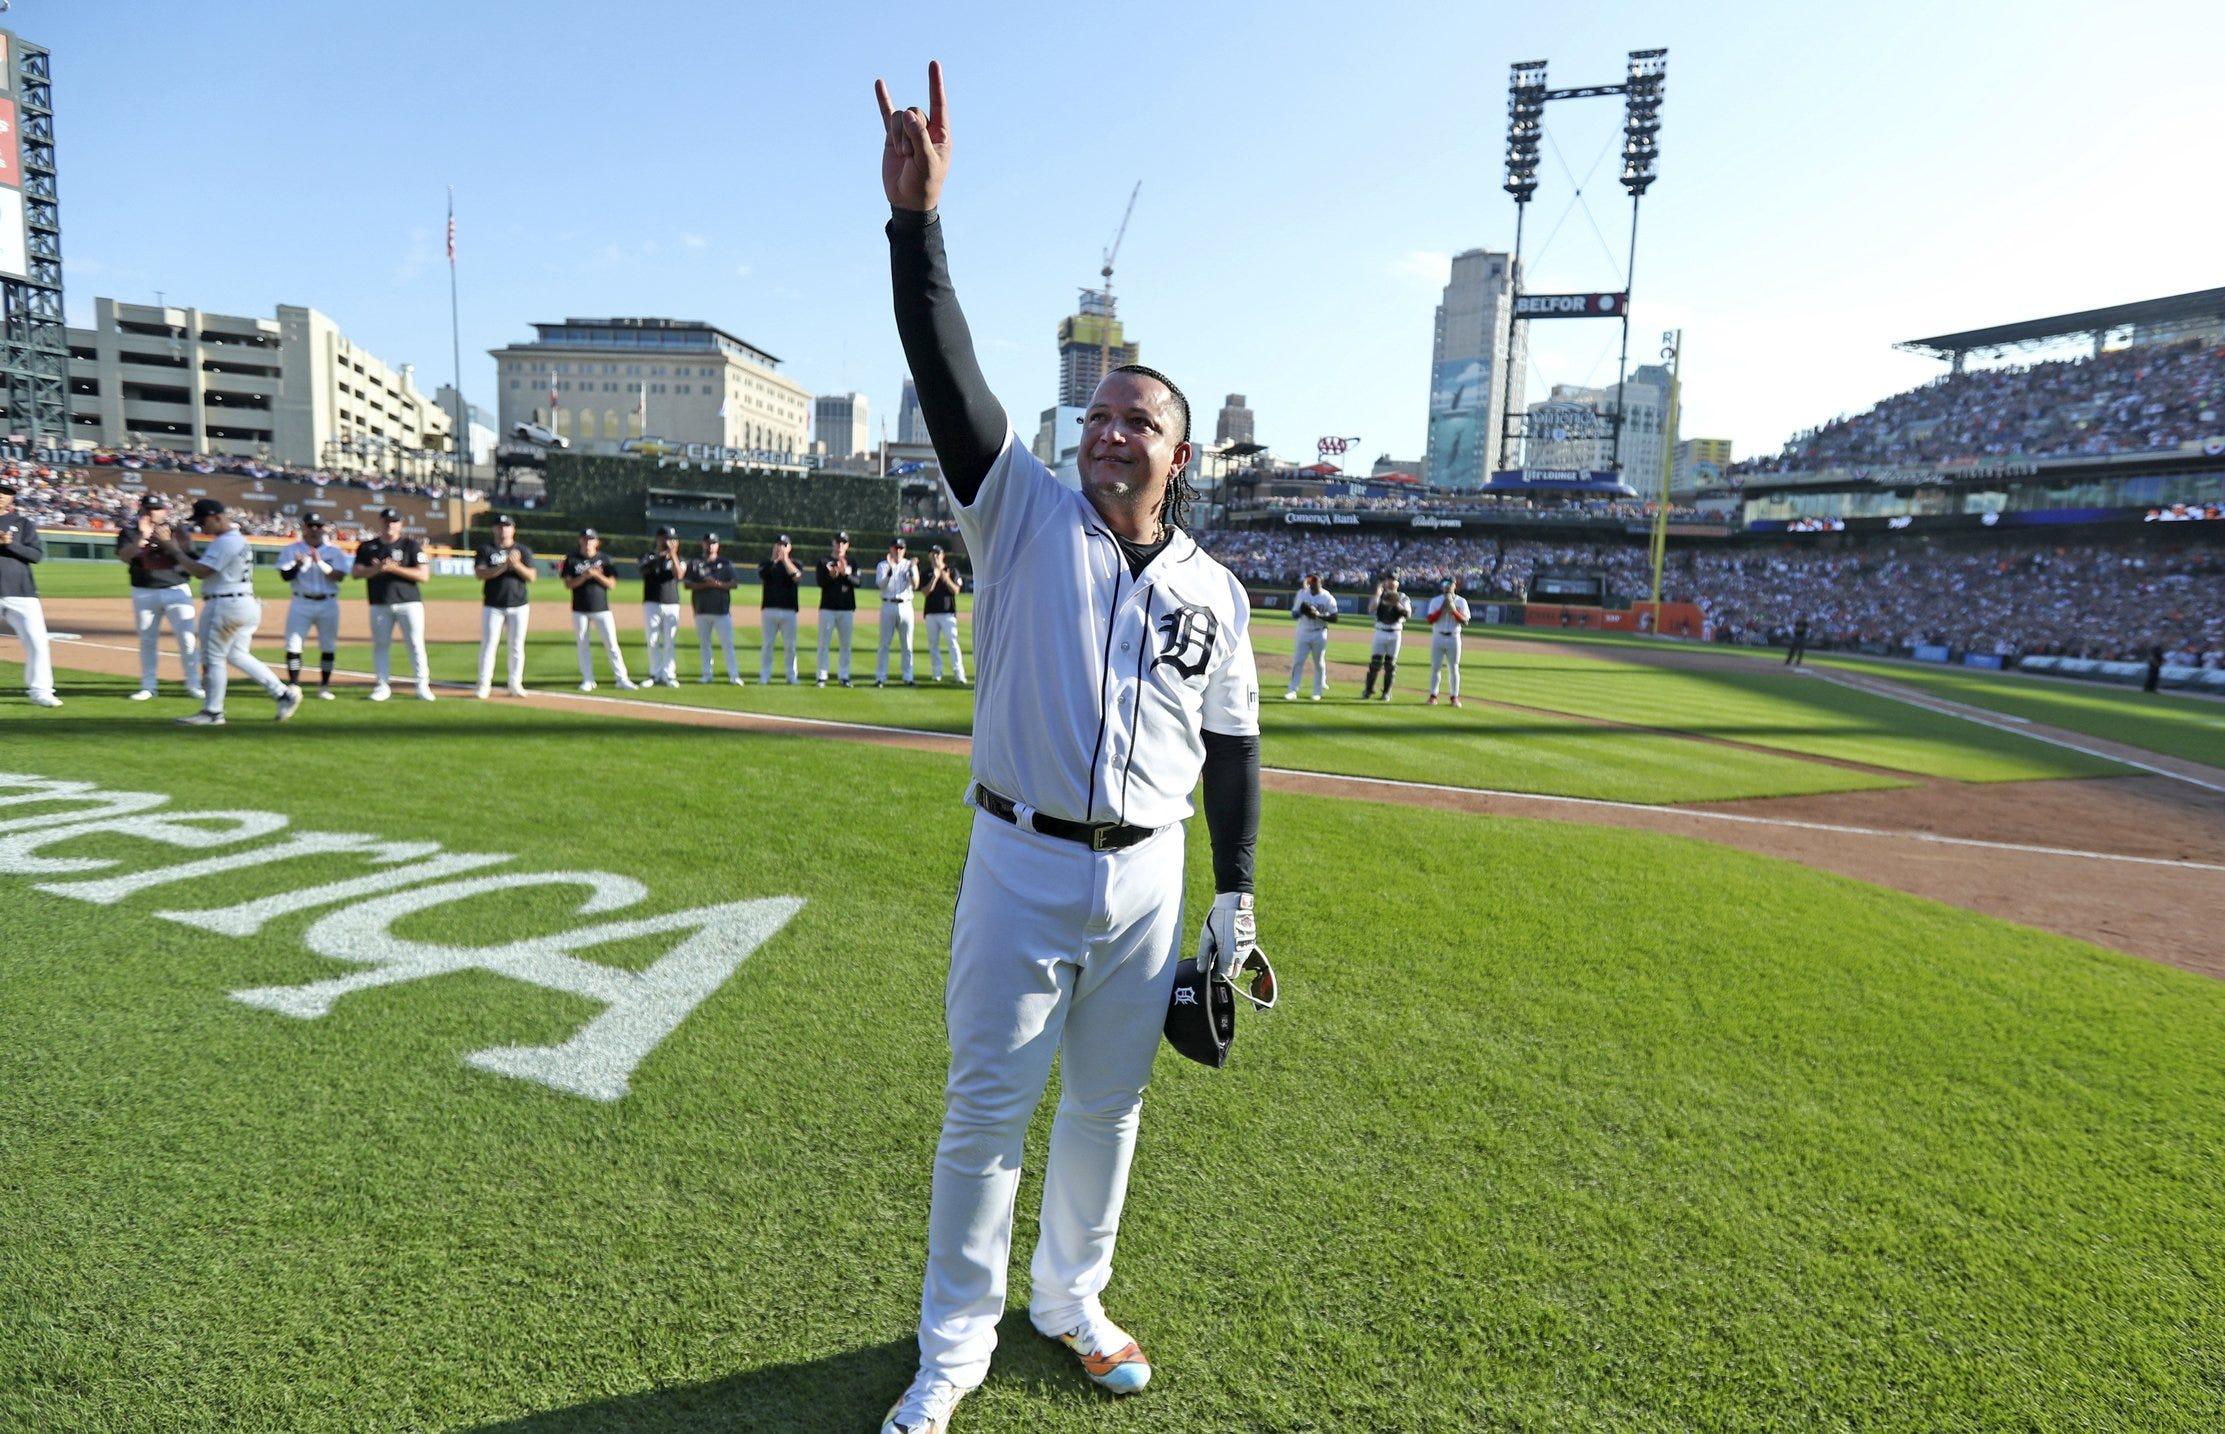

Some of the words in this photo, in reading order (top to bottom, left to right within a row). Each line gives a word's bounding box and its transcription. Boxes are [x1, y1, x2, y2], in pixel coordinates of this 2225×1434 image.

[1517, 296, 1586, 312] BELFOR
[687, 443, 824, 469] CHEVROLET
[1333, 514, 1360, 525] Bank
[1149, 586, 1219, 680] D
